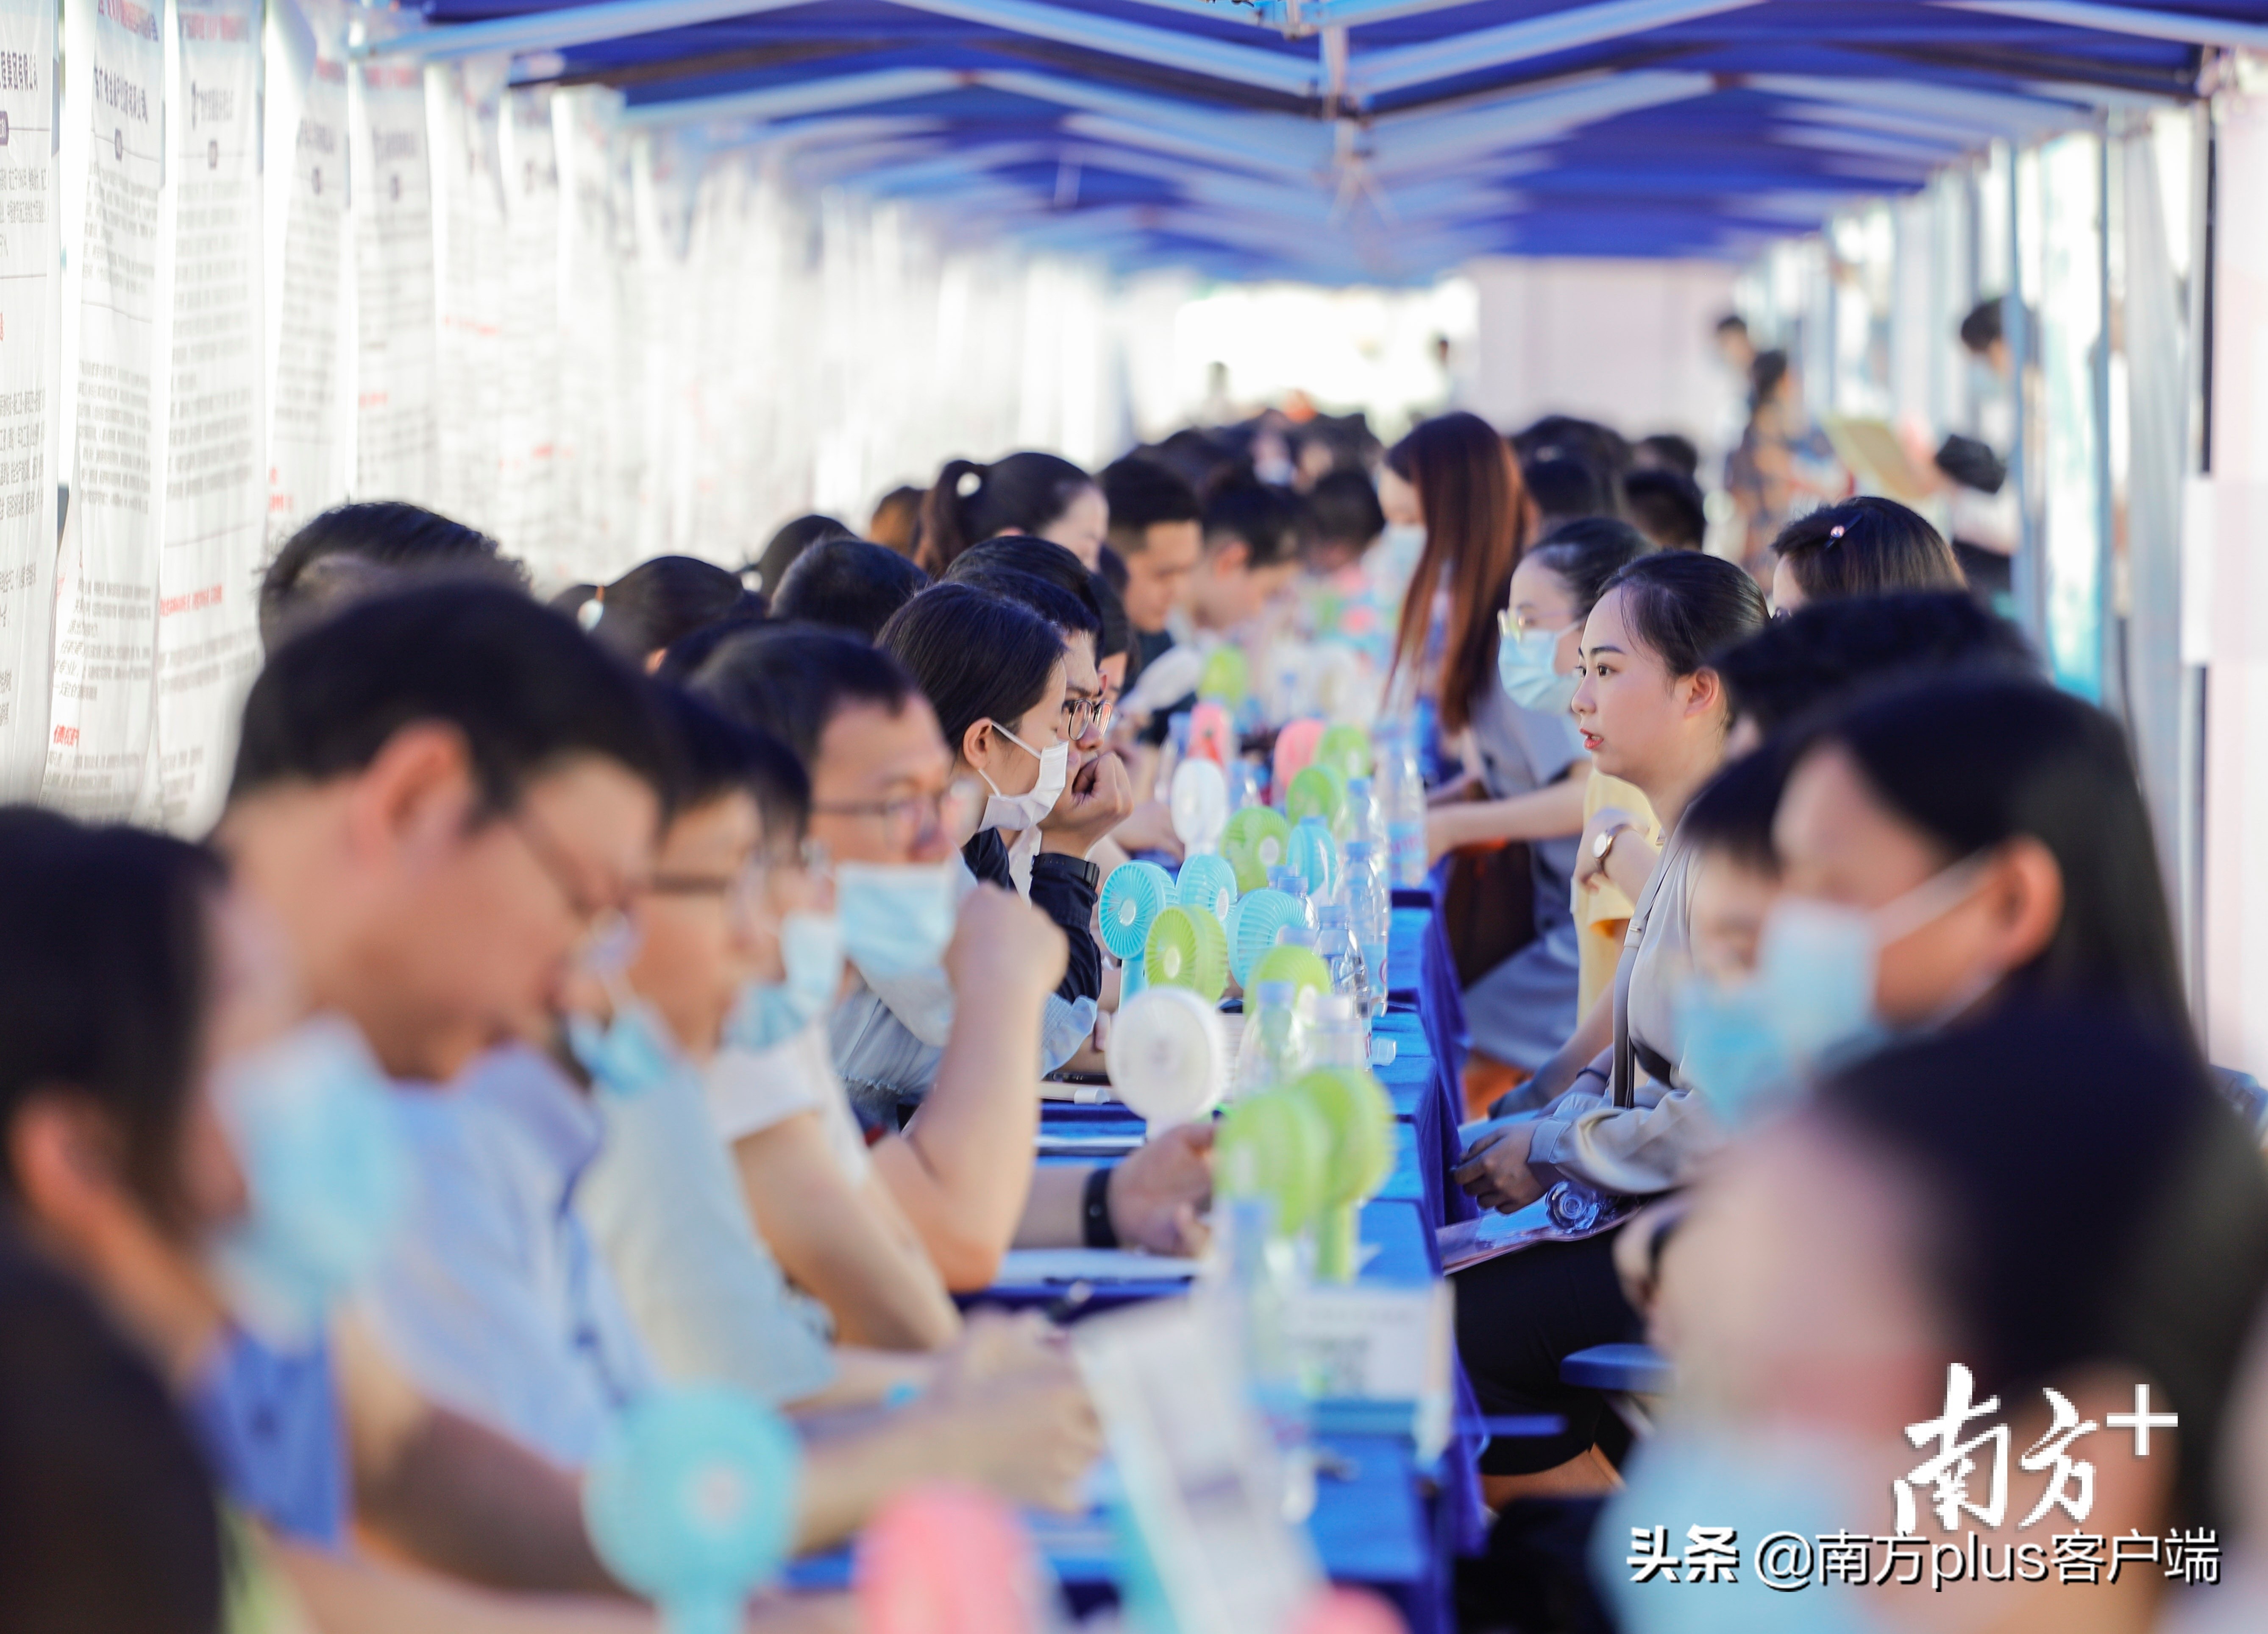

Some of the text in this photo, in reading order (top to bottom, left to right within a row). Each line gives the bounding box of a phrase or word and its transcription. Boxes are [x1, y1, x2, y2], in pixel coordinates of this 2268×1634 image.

[0, 50, 38, 92] 程集团有限公司
